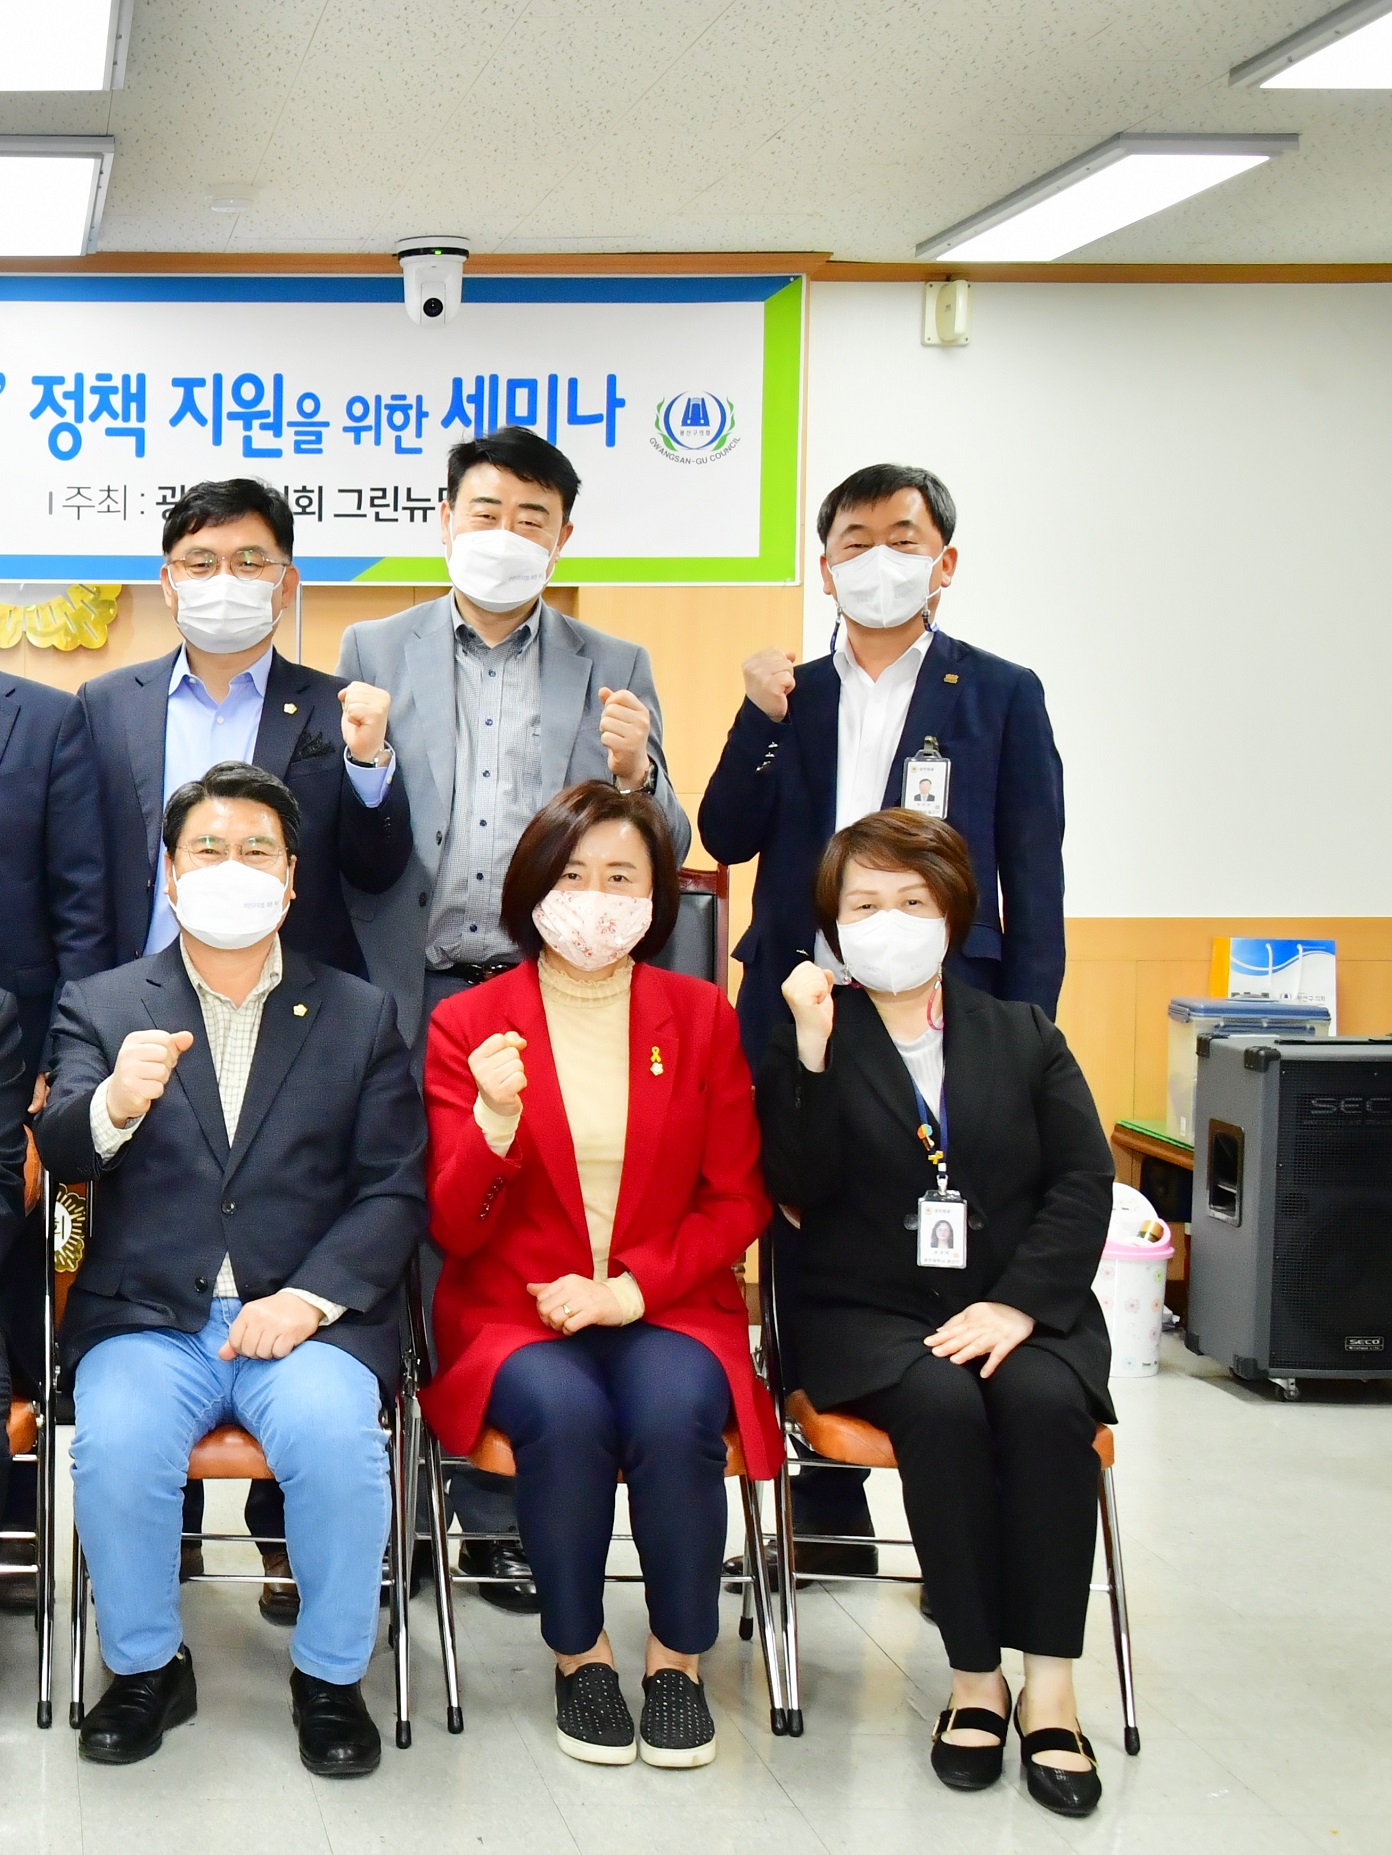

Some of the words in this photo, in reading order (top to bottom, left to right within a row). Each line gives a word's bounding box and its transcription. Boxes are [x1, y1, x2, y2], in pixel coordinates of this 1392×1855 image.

[30, 372, 148, 462] 정책
[170, 372, 332, 460] 지원을
[343, 394, 431, 456] 위한
[440, 373, 627, 449] 세미나
[649, 437, 708, 464] GWANGSAN-GU
[709, 436, 742, 462] COUNCIL
[61, 484, 128, 522] 주최
[333, 485, 448, 523] 그린뉴
